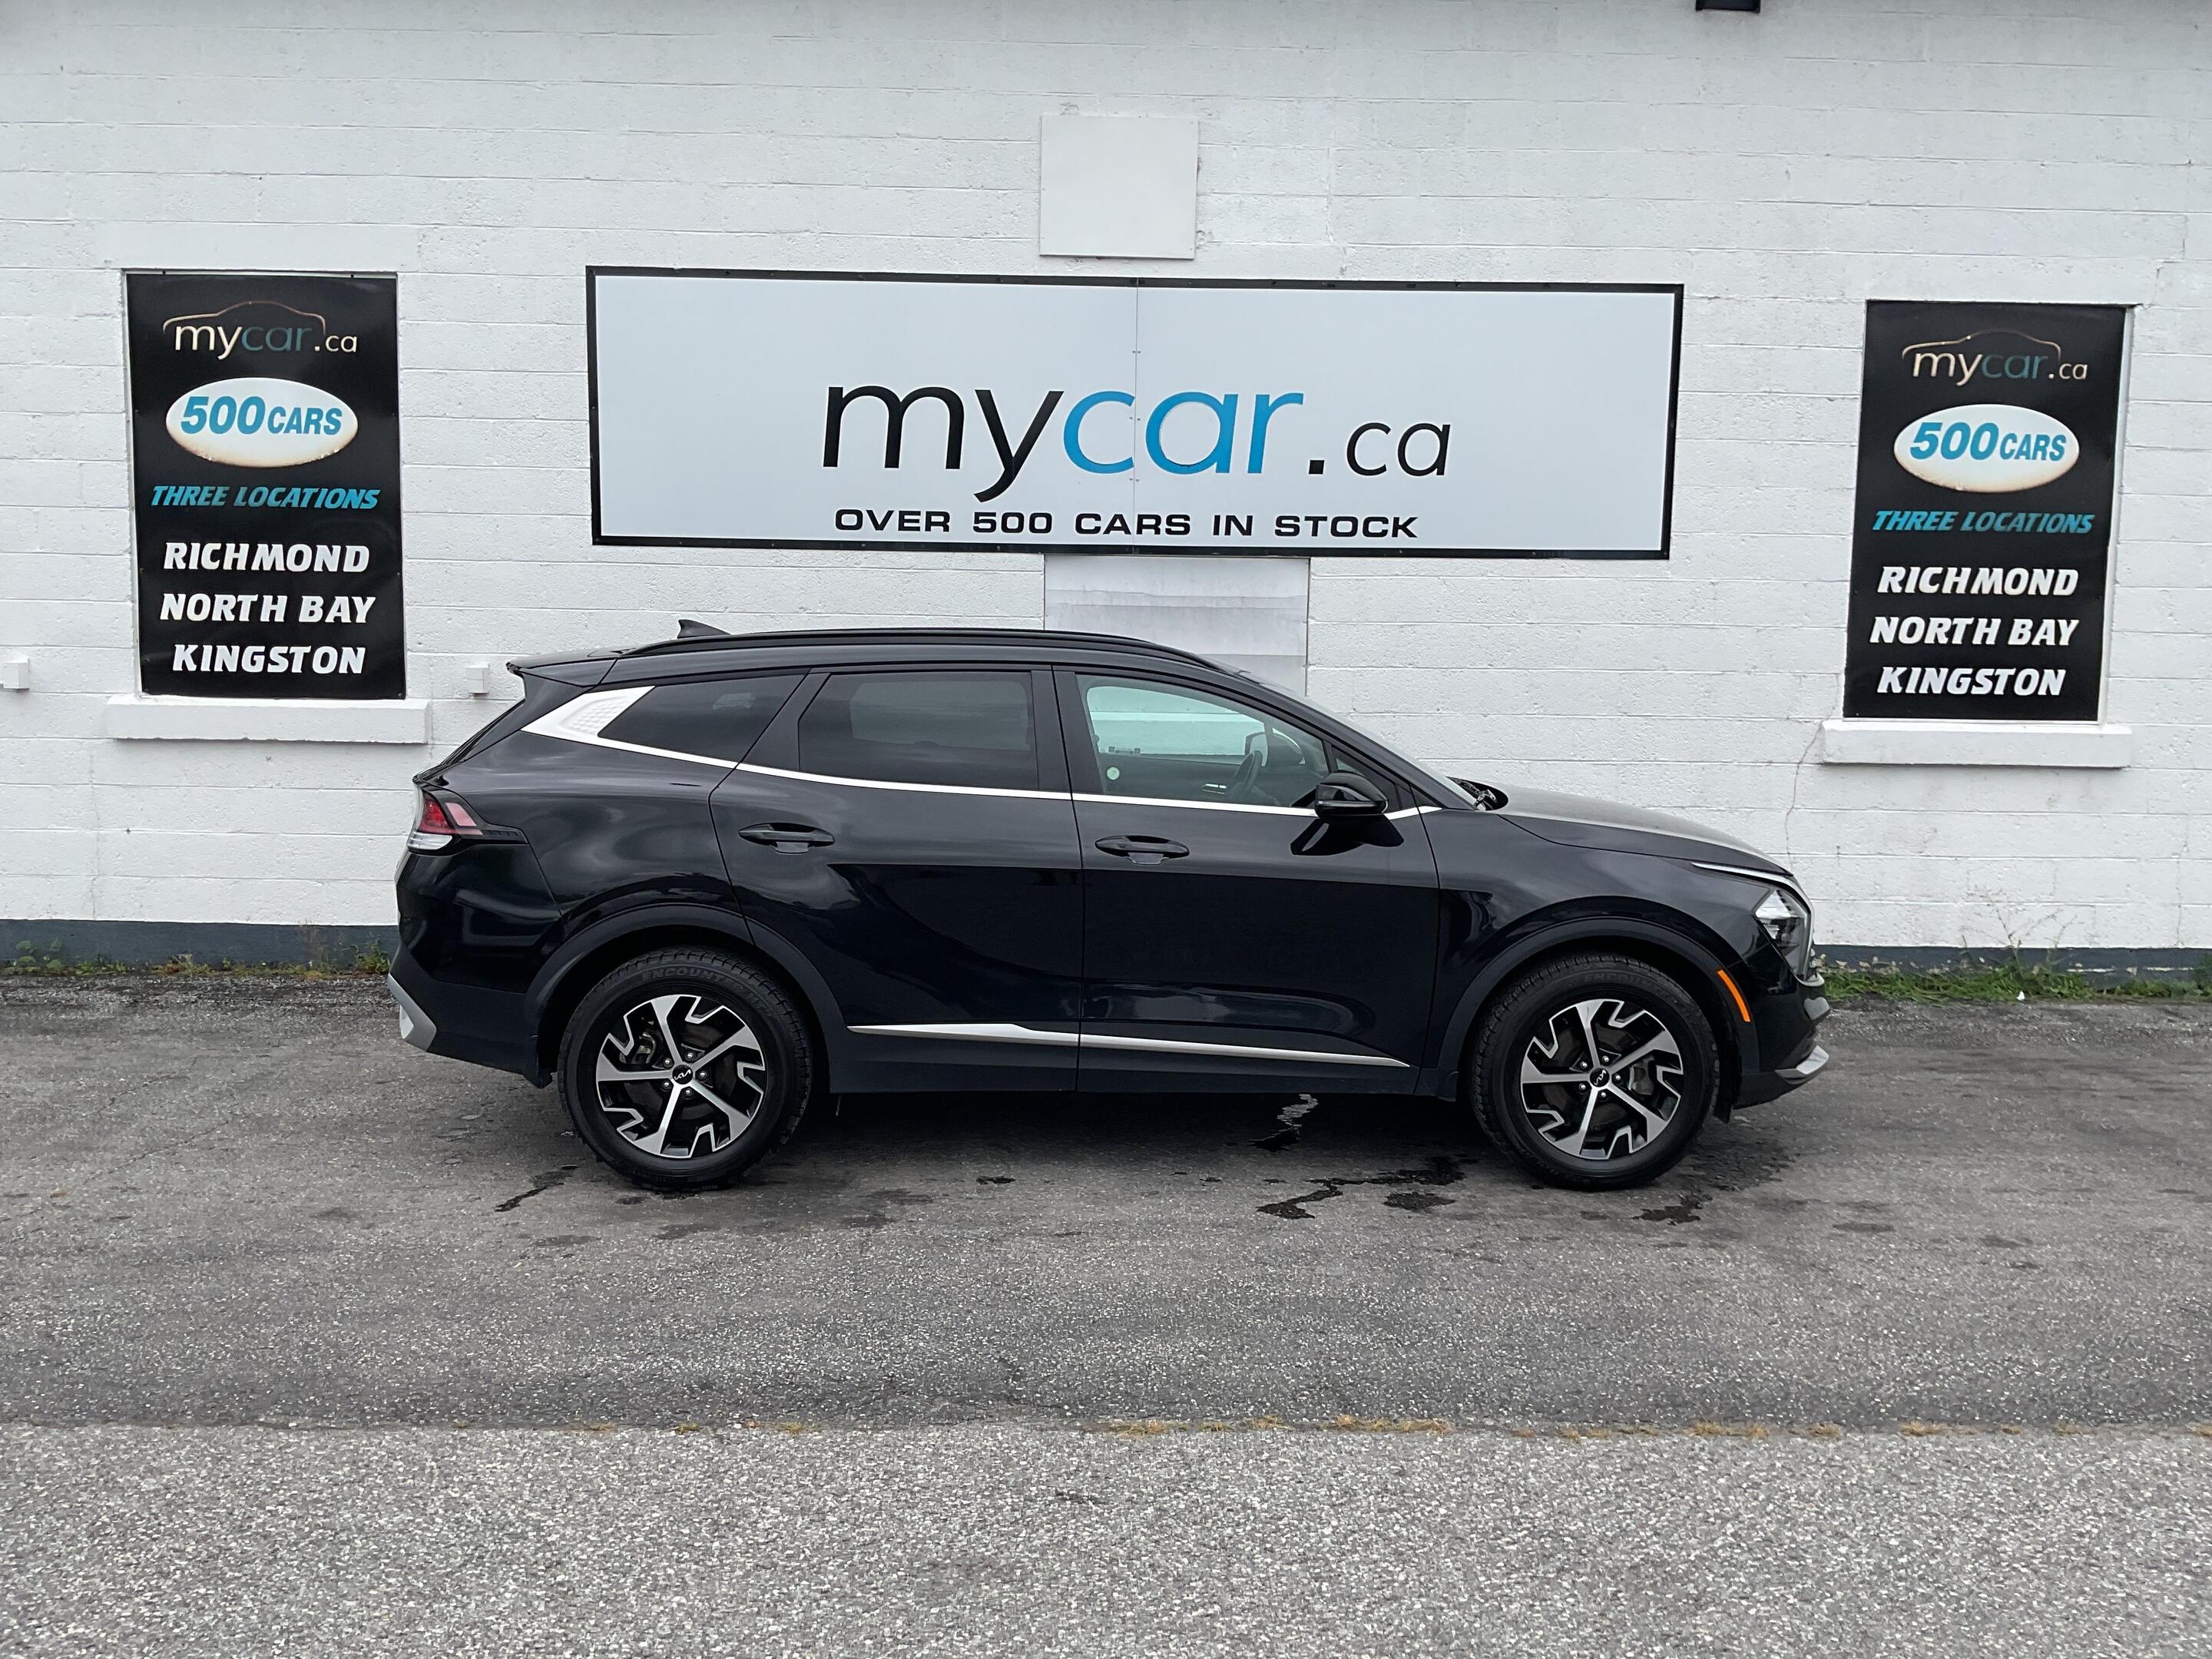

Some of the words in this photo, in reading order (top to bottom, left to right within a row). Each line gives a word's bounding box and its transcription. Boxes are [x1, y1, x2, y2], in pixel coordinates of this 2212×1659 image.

[175, 323, 357, 360] mycar.ca
[1912, 352, 2088, 386] mycar.ca
[180, 395, 267, 435] 500
[267, 405, 343, 436] CARS
[823, 386, 1451, 503] mycar.ca
[1909, 420, 1999, 462] 500
[1998, 432, 2068, 462] CARS
[151, 485, 229, 508] THREE
[233, 486, 382, 510] LOCATIONS
[835, 508, 951, 533] OVER
[972, 512, 1053, 535] 500
[1075, 513, 1190, 536] CARS
[1213, 515, 1253, 537] IN
[1274, 515, 1418, 539] STOCK
[1872, 508, 1956, 532] THREE
[1961, 511, 2094, 535] LOCATIONS
[163, 541, 370, 573] RICHMOND
[1876, 566, 2079, 596] RICHMOND
[159, 593, 288, 623] NORTH
[298, 595, 376, 624] BAY
[1869, 616, 2001, 645] NORTH
[2007, 618, 2080, 646] BAY
[172, 644, 366, 674] KINGSTON
[1876, 666, 2067, 696] KINGSTON
